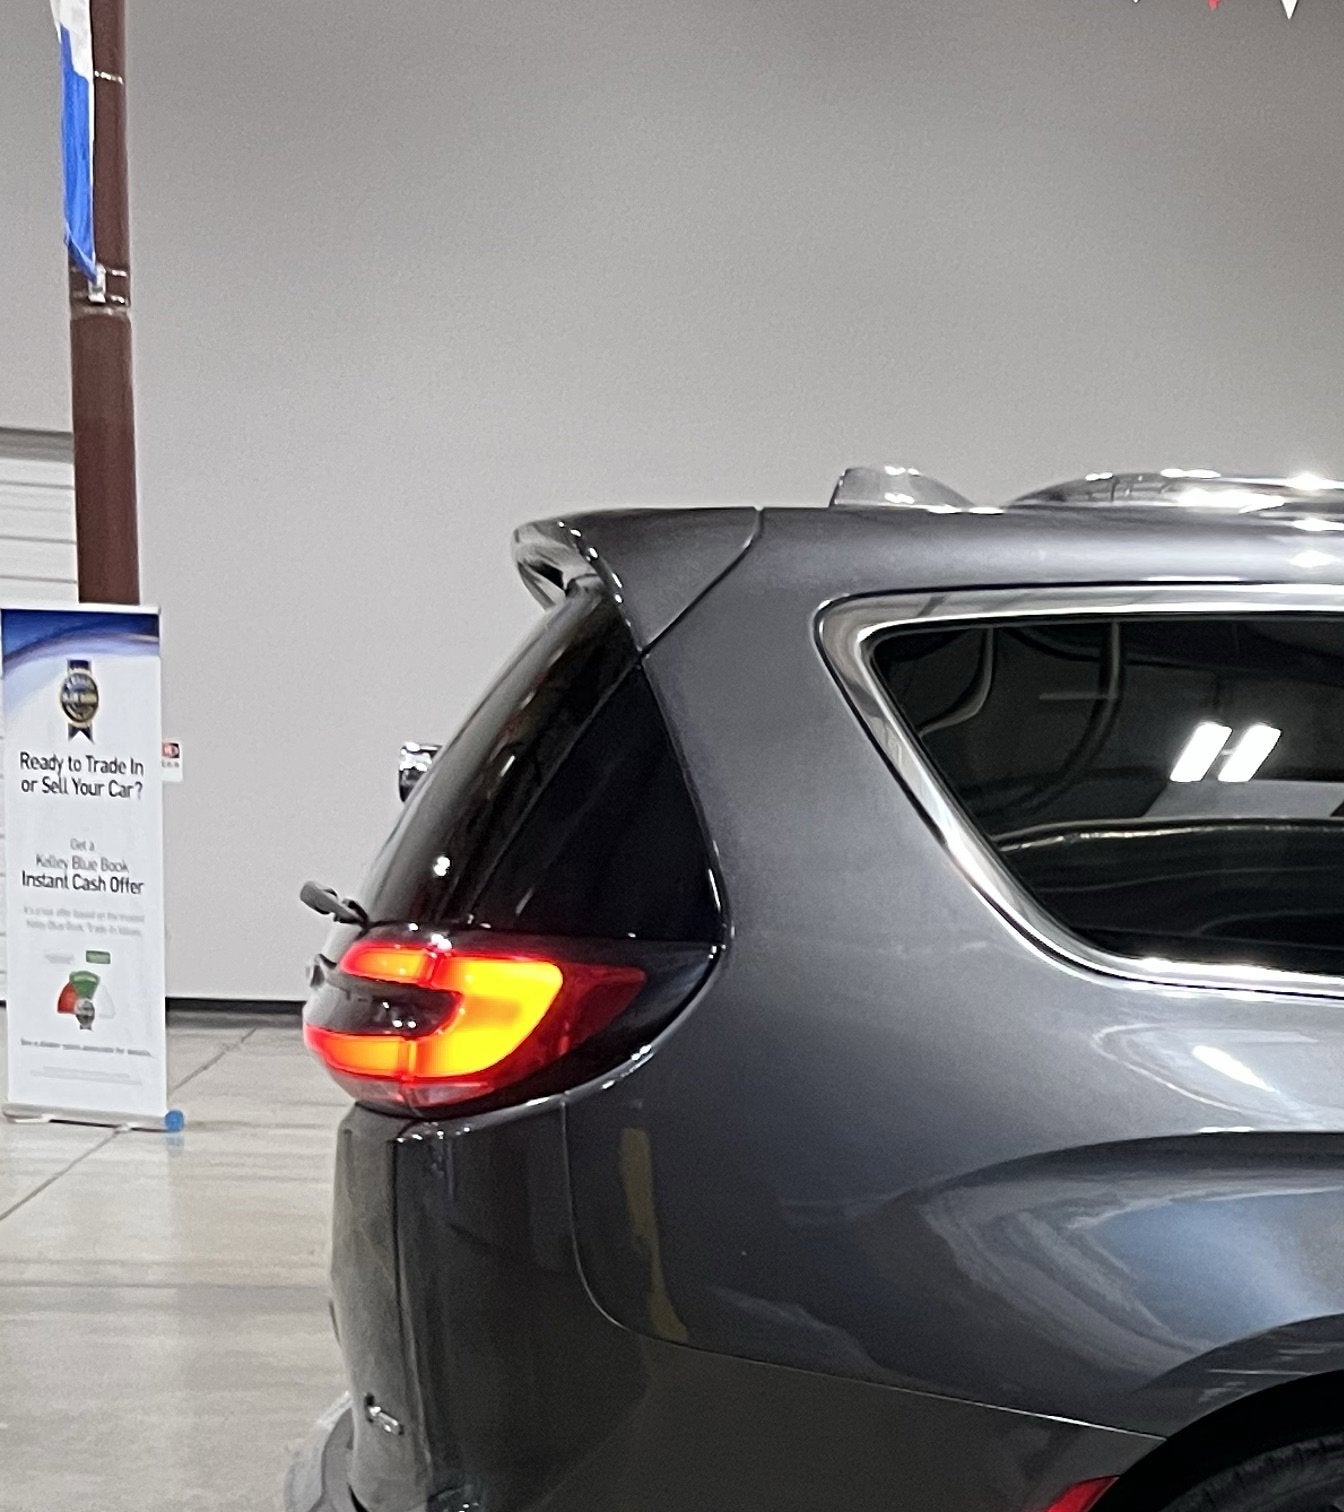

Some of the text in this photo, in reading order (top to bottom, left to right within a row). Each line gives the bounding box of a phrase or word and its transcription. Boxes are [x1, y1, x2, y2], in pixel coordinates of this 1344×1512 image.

[20, 752, 144, 776] Ready to Trade In
[21, 776, 143, 800] or Sell Your Car?
[70, 838, 95, 851] Get a
[36, 854, 130, 873] Kelley Blue Book
[22, 870, 145, 894] Instant Cash Offer
